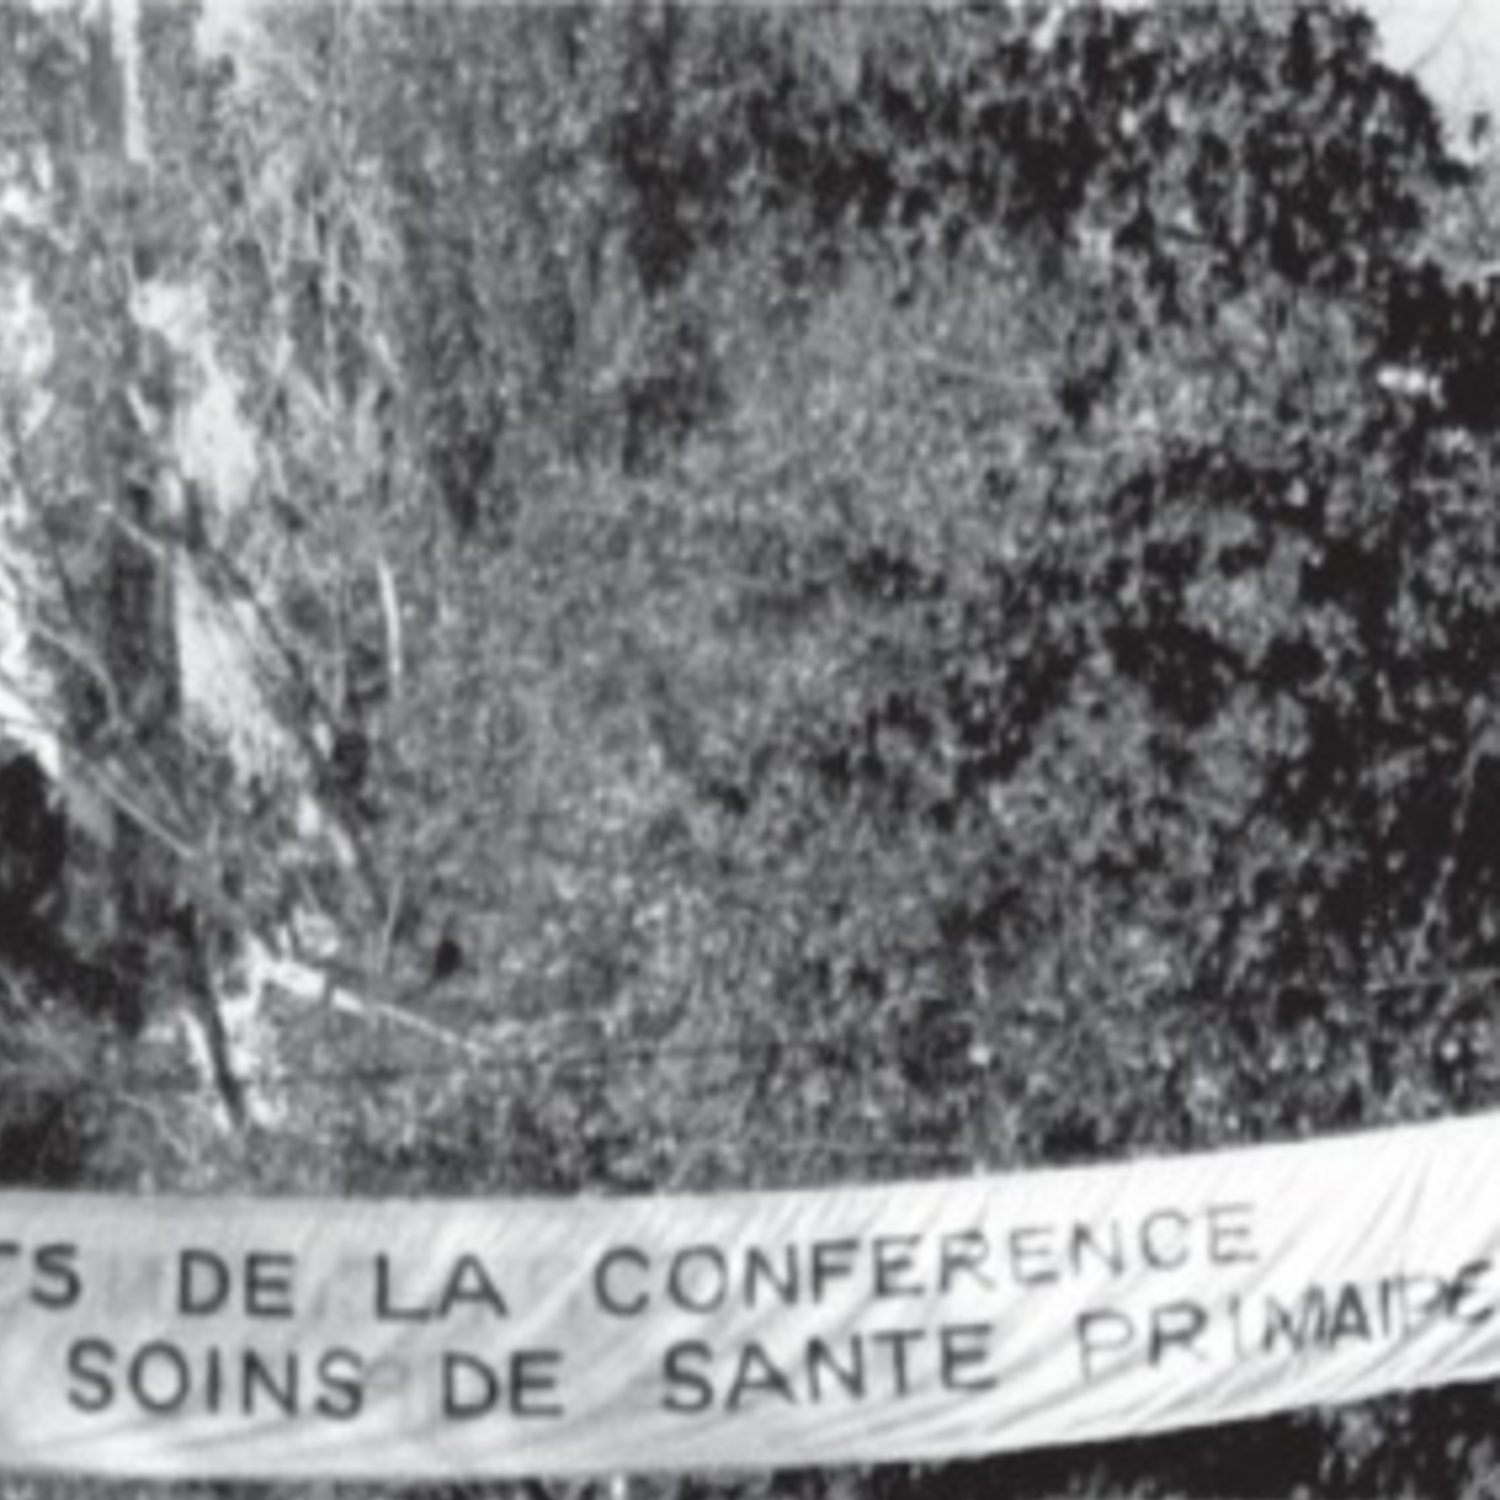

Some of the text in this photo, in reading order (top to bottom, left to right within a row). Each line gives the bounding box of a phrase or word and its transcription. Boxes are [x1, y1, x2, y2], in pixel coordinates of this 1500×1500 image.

[177, 1248, 297, 1319] DE
[373, 1251, 509, 1323] LA
[591, 1201, 1260, 1318] CONFERENCE
[65, 1338, 366, 1421] SOINS
[440, 1350, 566, 1420] DE
[660, 1322, 1000, 1414] SANTE
